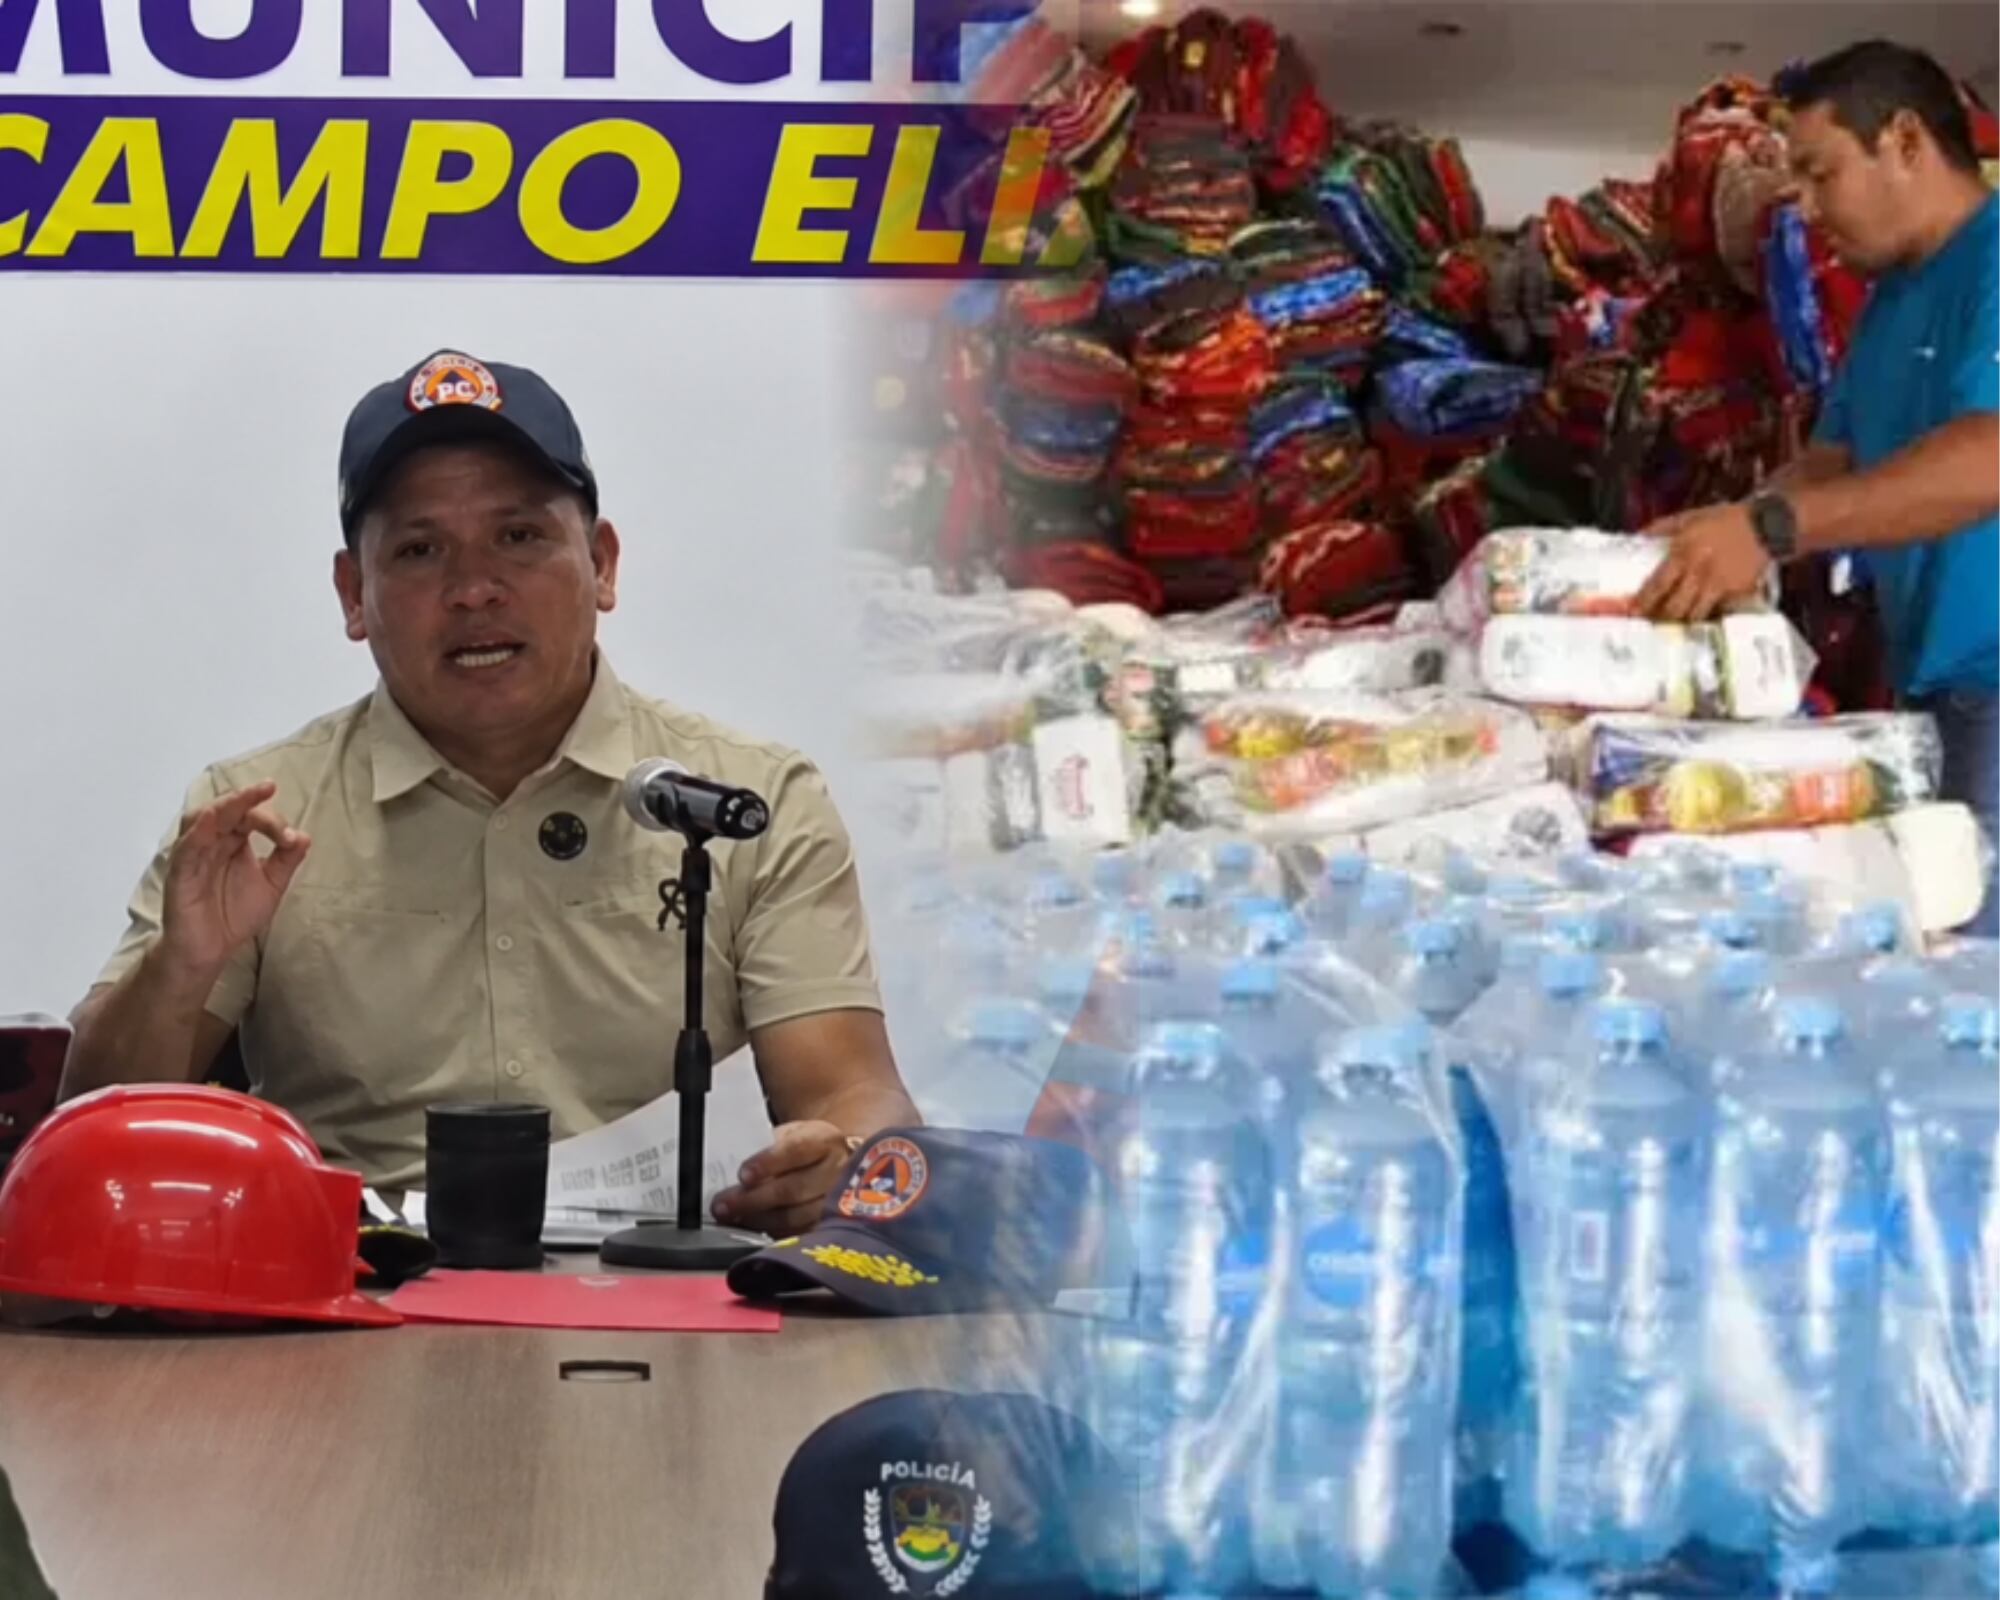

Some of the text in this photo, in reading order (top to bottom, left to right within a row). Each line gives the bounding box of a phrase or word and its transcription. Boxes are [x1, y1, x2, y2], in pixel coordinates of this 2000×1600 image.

[0, 0, 1040, 85] UNICI
[750, 123, 1090, 266] ELI
[437, 381, 478, 402] PC
